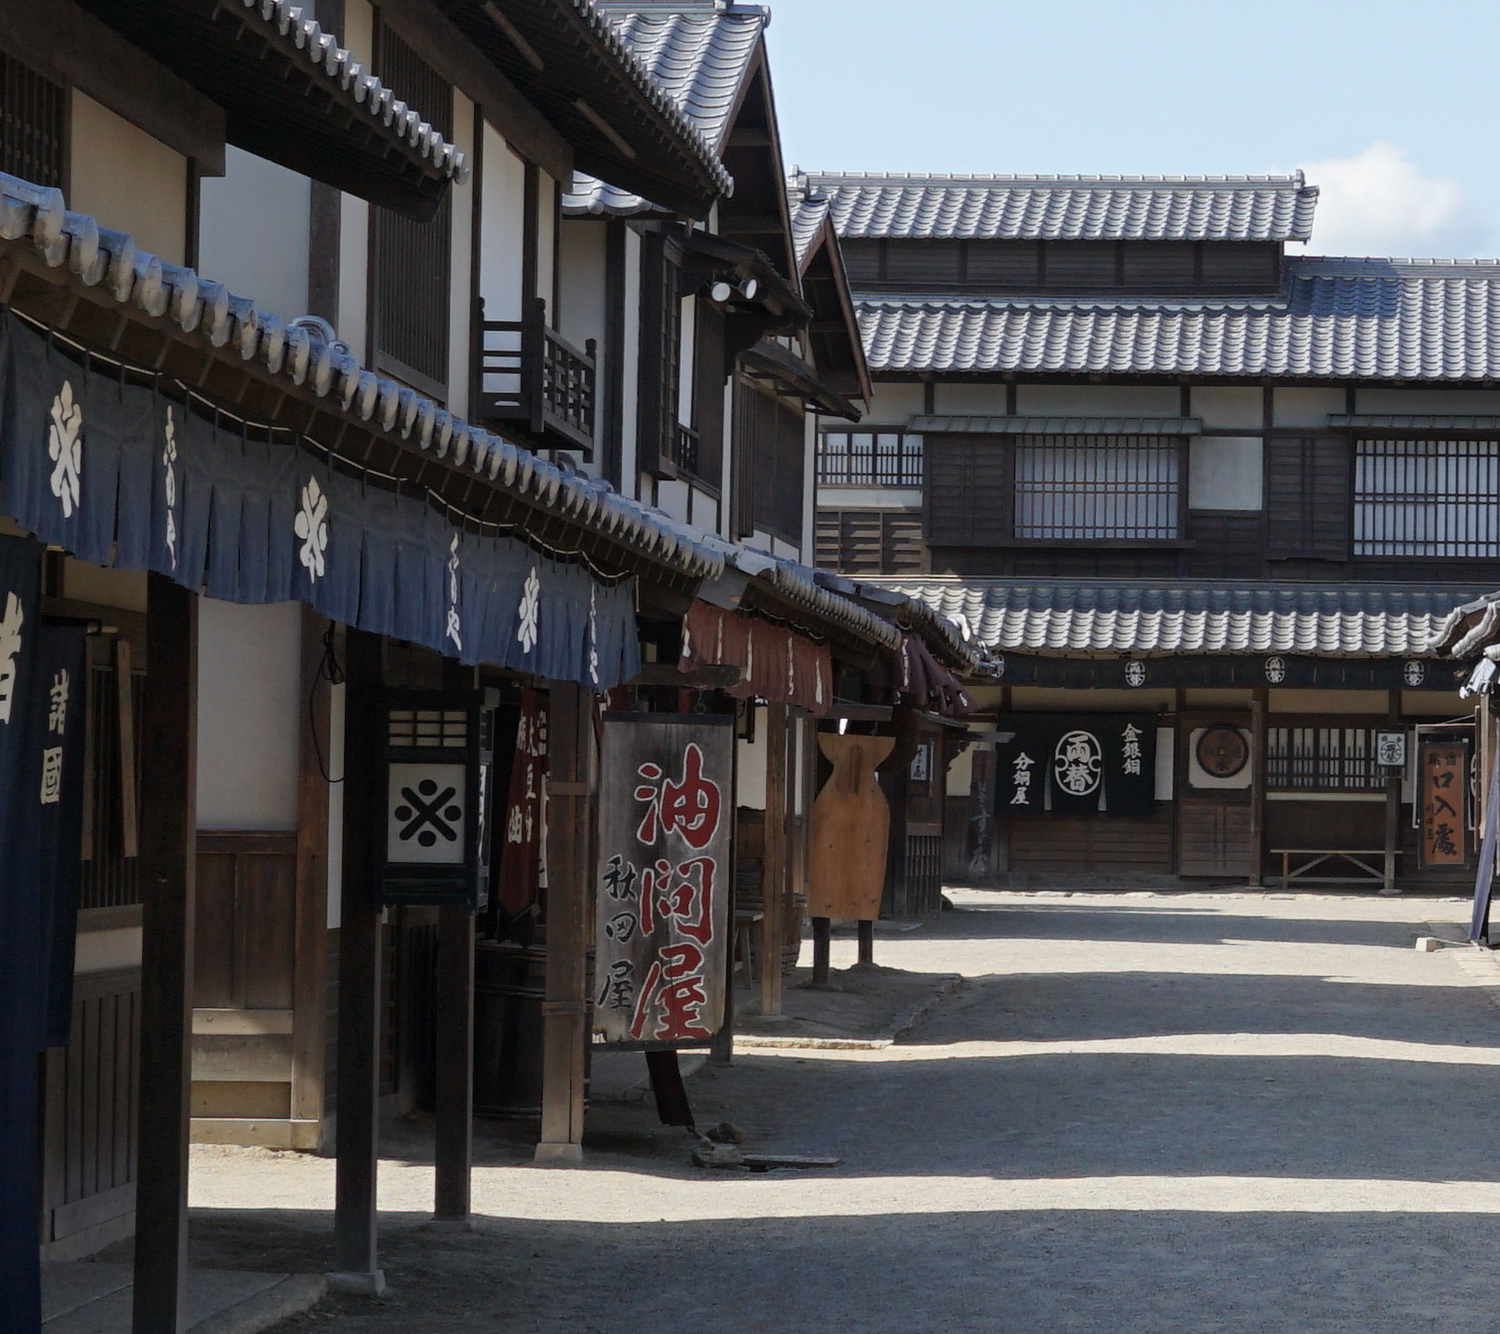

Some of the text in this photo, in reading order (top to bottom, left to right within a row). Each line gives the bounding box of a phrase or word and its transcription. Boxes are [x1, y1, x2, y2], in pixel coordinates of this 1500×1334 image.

[1064, 734, 1093, 792] 両替
[598, 855, 637, 1009] 秋田屋
[630, 742, 721, 1041] 油問屋
